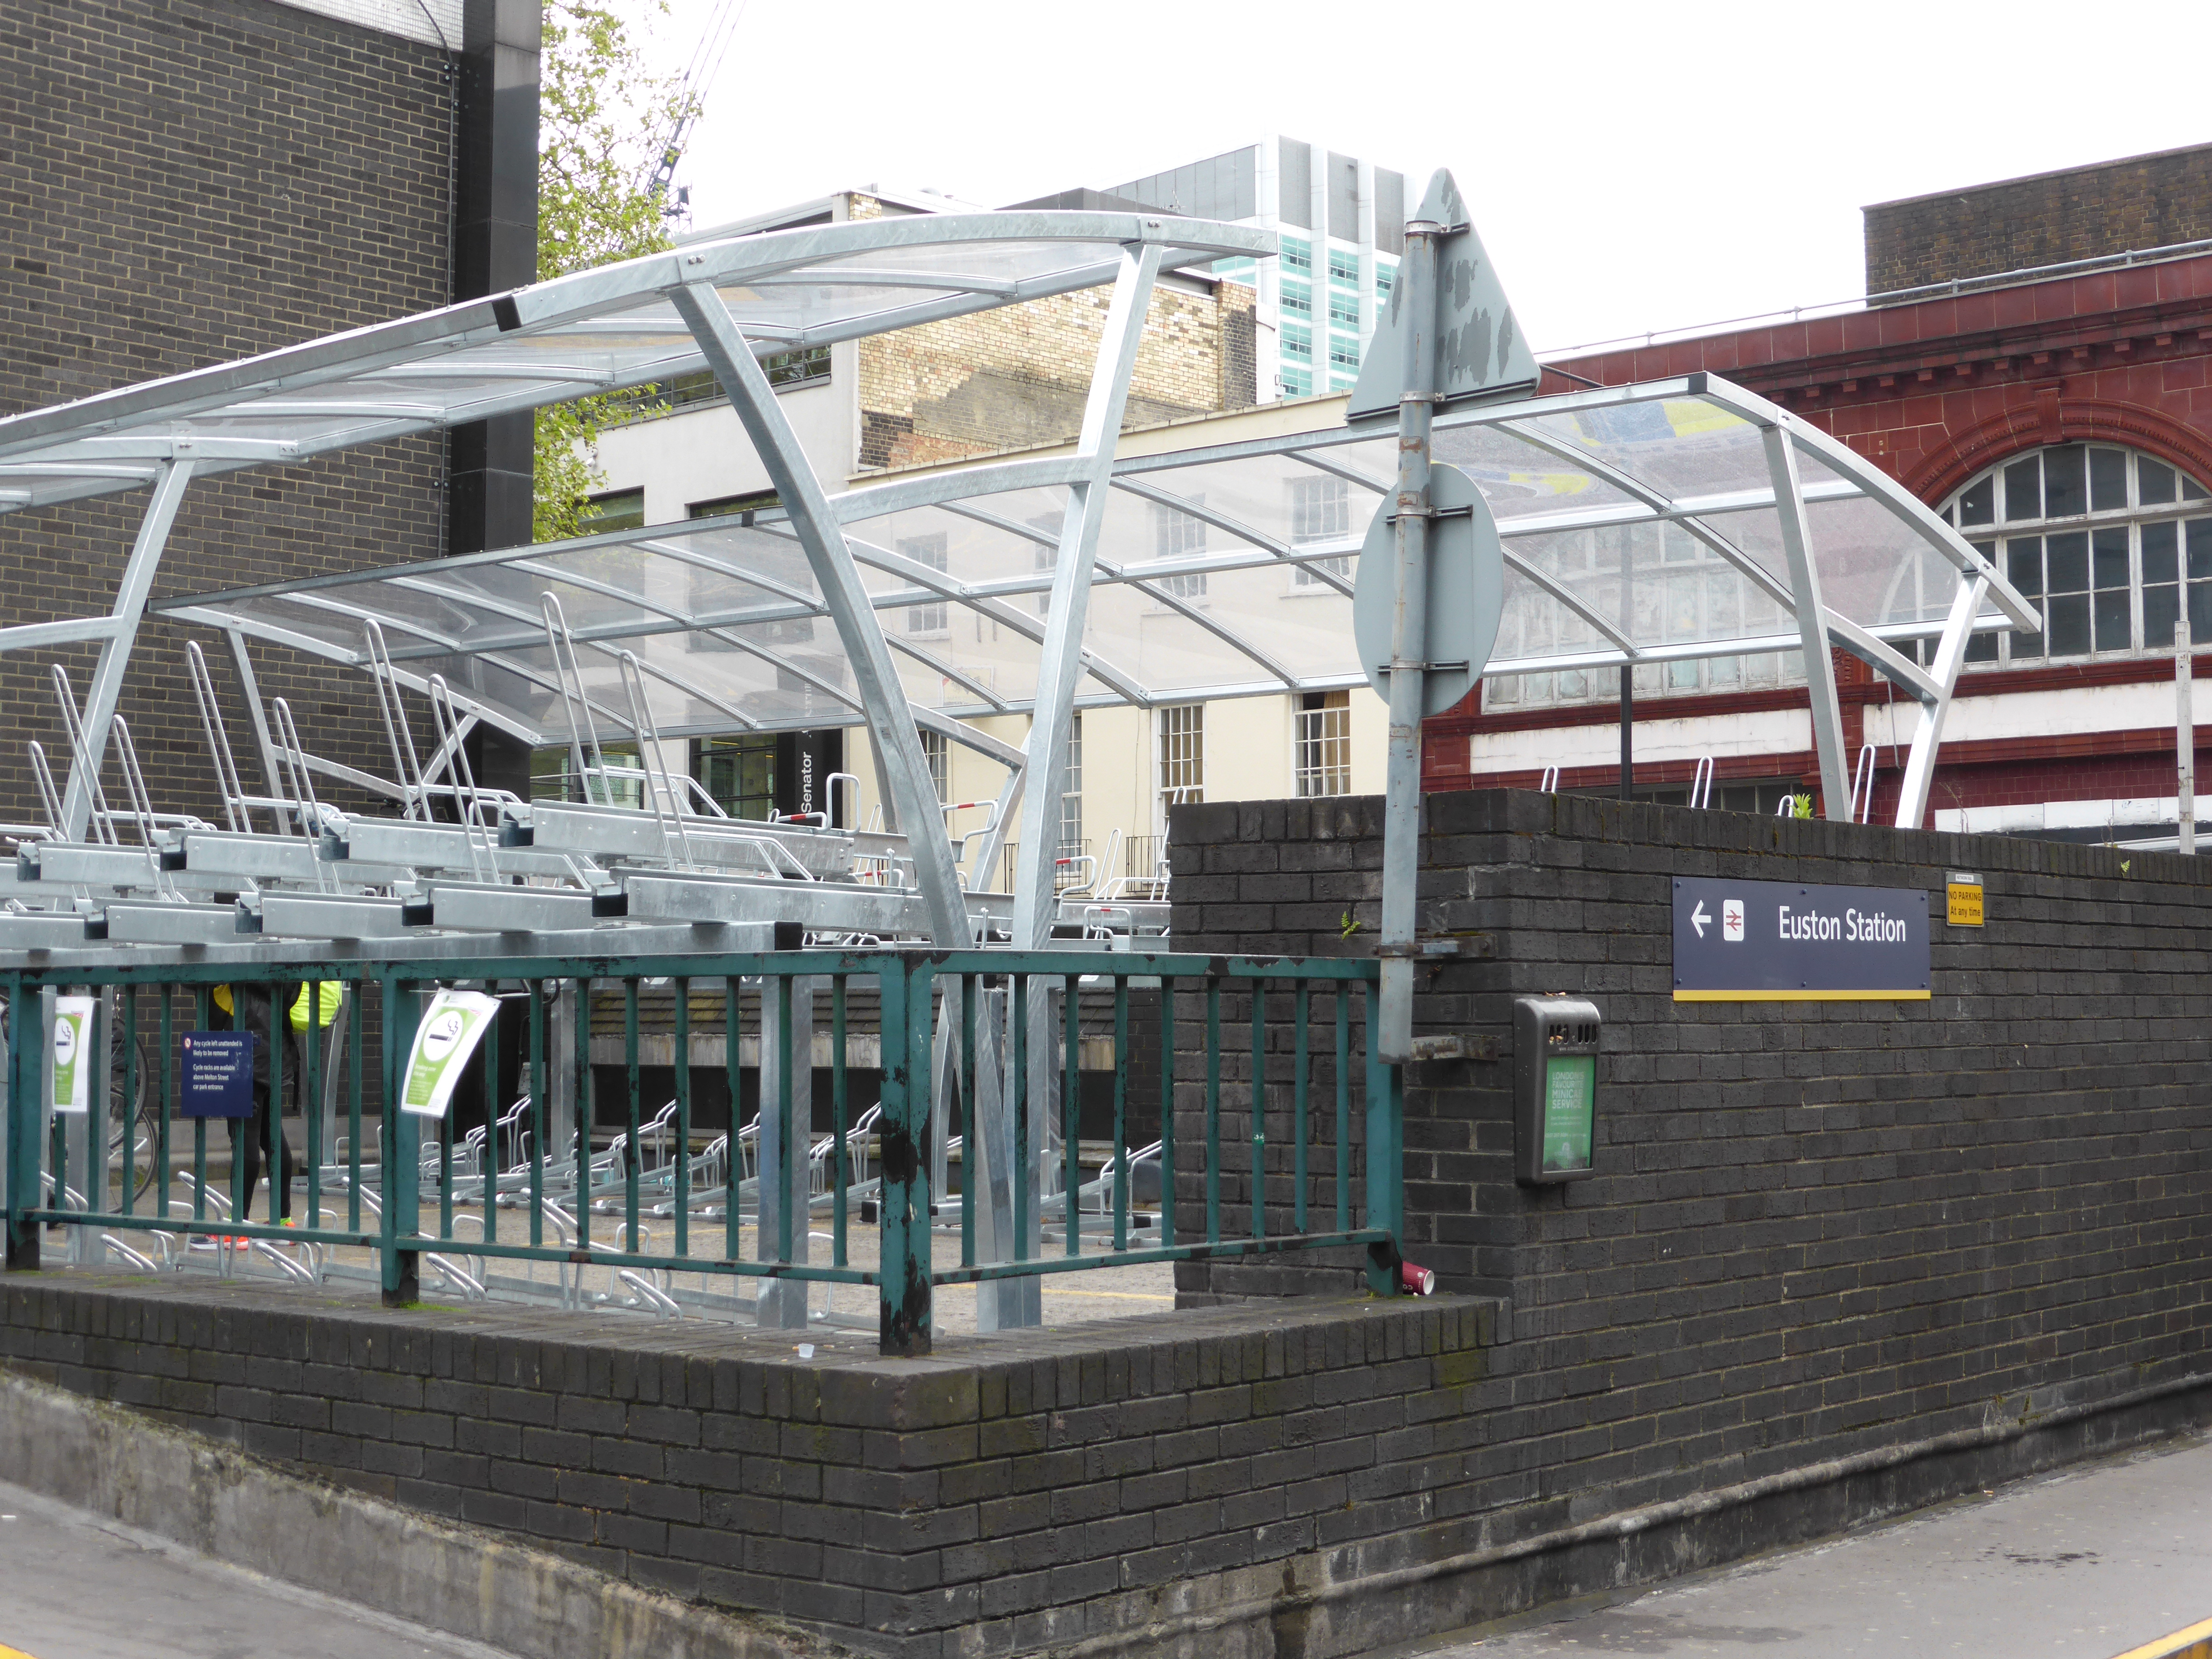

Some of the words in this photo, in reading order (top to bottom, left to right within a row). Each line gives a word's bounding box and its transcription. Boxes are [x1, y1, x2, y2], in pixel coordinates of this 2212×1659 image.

[801, 752, 812, 813] Senator
[1949, 891, 1957, 900] NO
[1959, 892, 1982, 901] PARKING
[1950, 905, 1956, 915] At
[1958, 908, 1968, 918] any
[1969, 907, 1981, 916] time
[1779, 905, 1841, 940] Euston
[1846, 908, 1906, 942] Station
[1552, 1089, 1584, 1099] MINICAB
[1552, 1099, 1582, 1109] SERVICE
